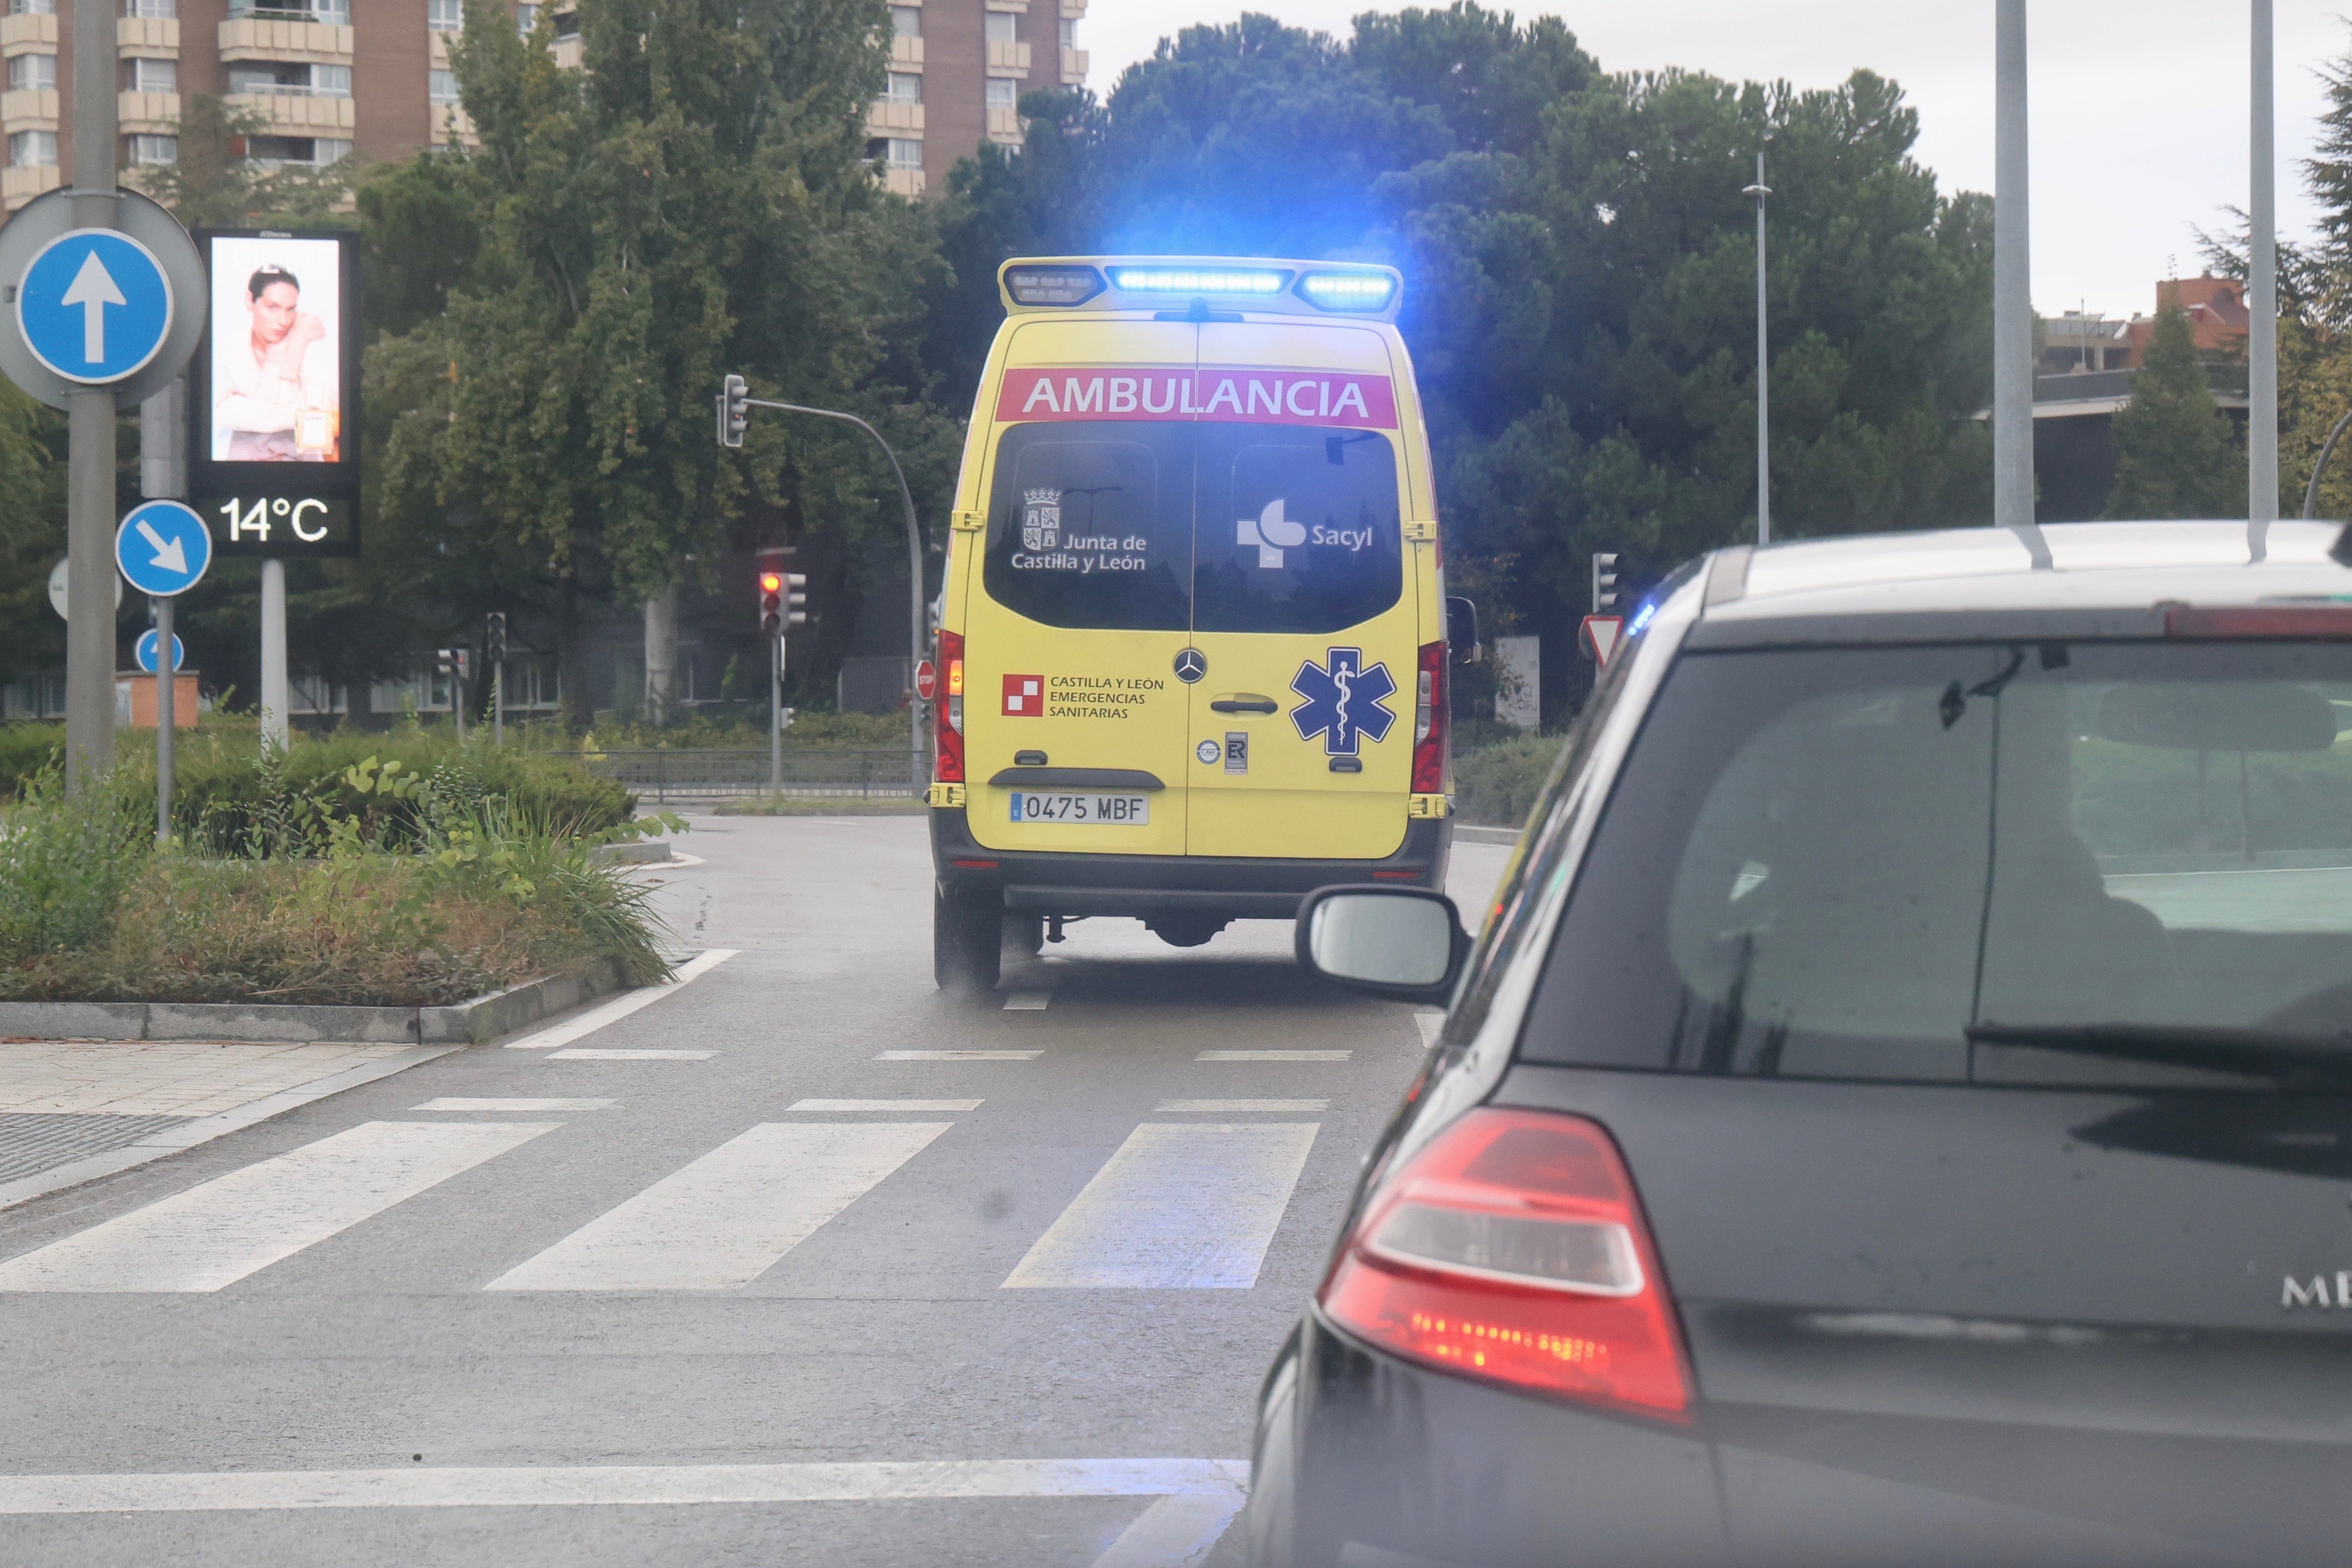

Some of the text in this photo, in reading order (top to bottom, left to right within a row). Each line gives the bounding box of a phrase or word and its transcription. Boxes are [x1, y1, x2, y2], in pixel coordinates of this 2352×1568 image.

[1022, 378, 1370, 418] AMBULANCIA
[220, 497, 328, 541] 14°C
[1063, 535, 1146, 550] Junta de
[1312, 525, 1372, 551] Sacyl
[1012, 554, 1145, 573] Castilla y León
[919, 675, 933, 685] STOP
[1051, 677, 1164, 689] CASTILLA Y LEÓN
[1050, 692, 1146, 704] EMERGENCIAS
[1049, 707, 1128, 718] SANITARIAS
[1027, 796, 1143, 820] 0475 MBF
